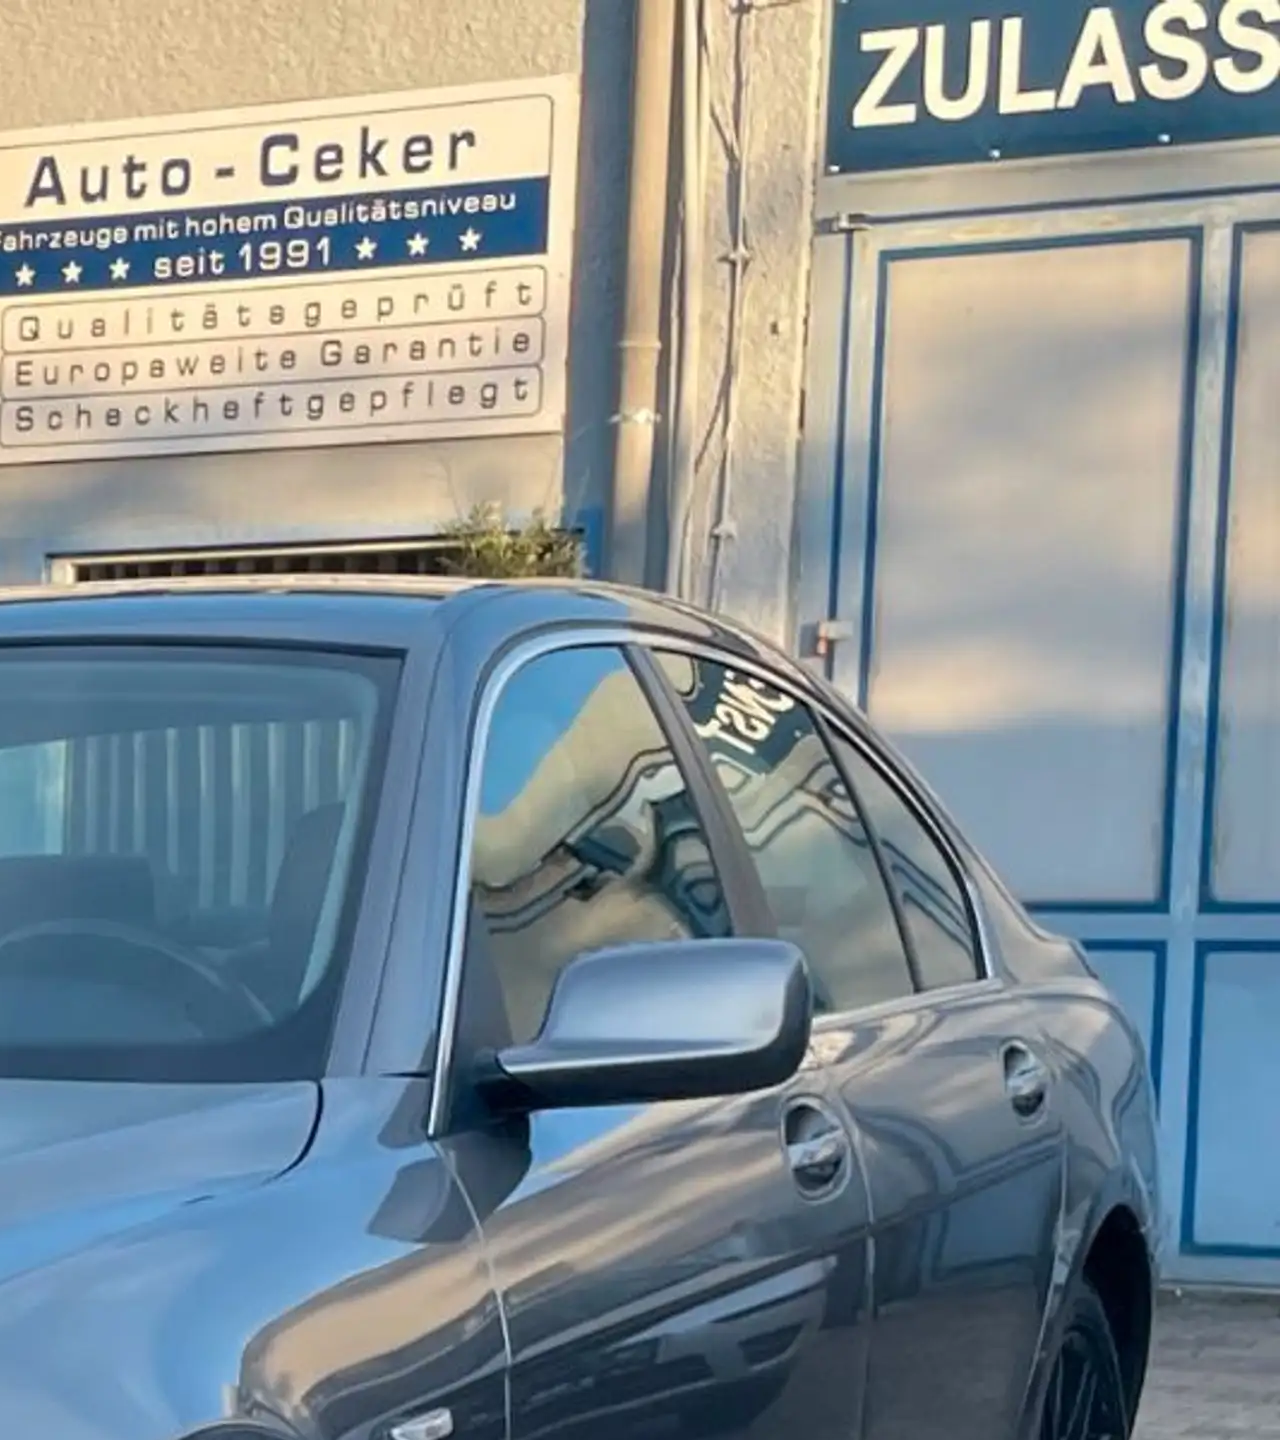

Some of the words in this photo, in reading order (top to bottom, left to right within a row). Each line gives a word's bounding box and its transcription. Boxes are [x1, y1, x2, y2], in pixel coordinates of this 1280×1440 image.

[851, 0, 1280, 128] ZULASS
[133, 217, 180, 242] mit
[184, 211, 278, 238] hohem
[283, 191, 517, 230] Qualitätsniveau
[153, 248, 226, 279] seit
[238, 235, 332, 273] 1991
[17, 280, 533, 343] Qualitätsgeprüft
[15, 344, 297, 387] Europaweite
[319, 326, 530, 368] Garantie
[14, 376, 529, 433] Scheckheftgepflegt
